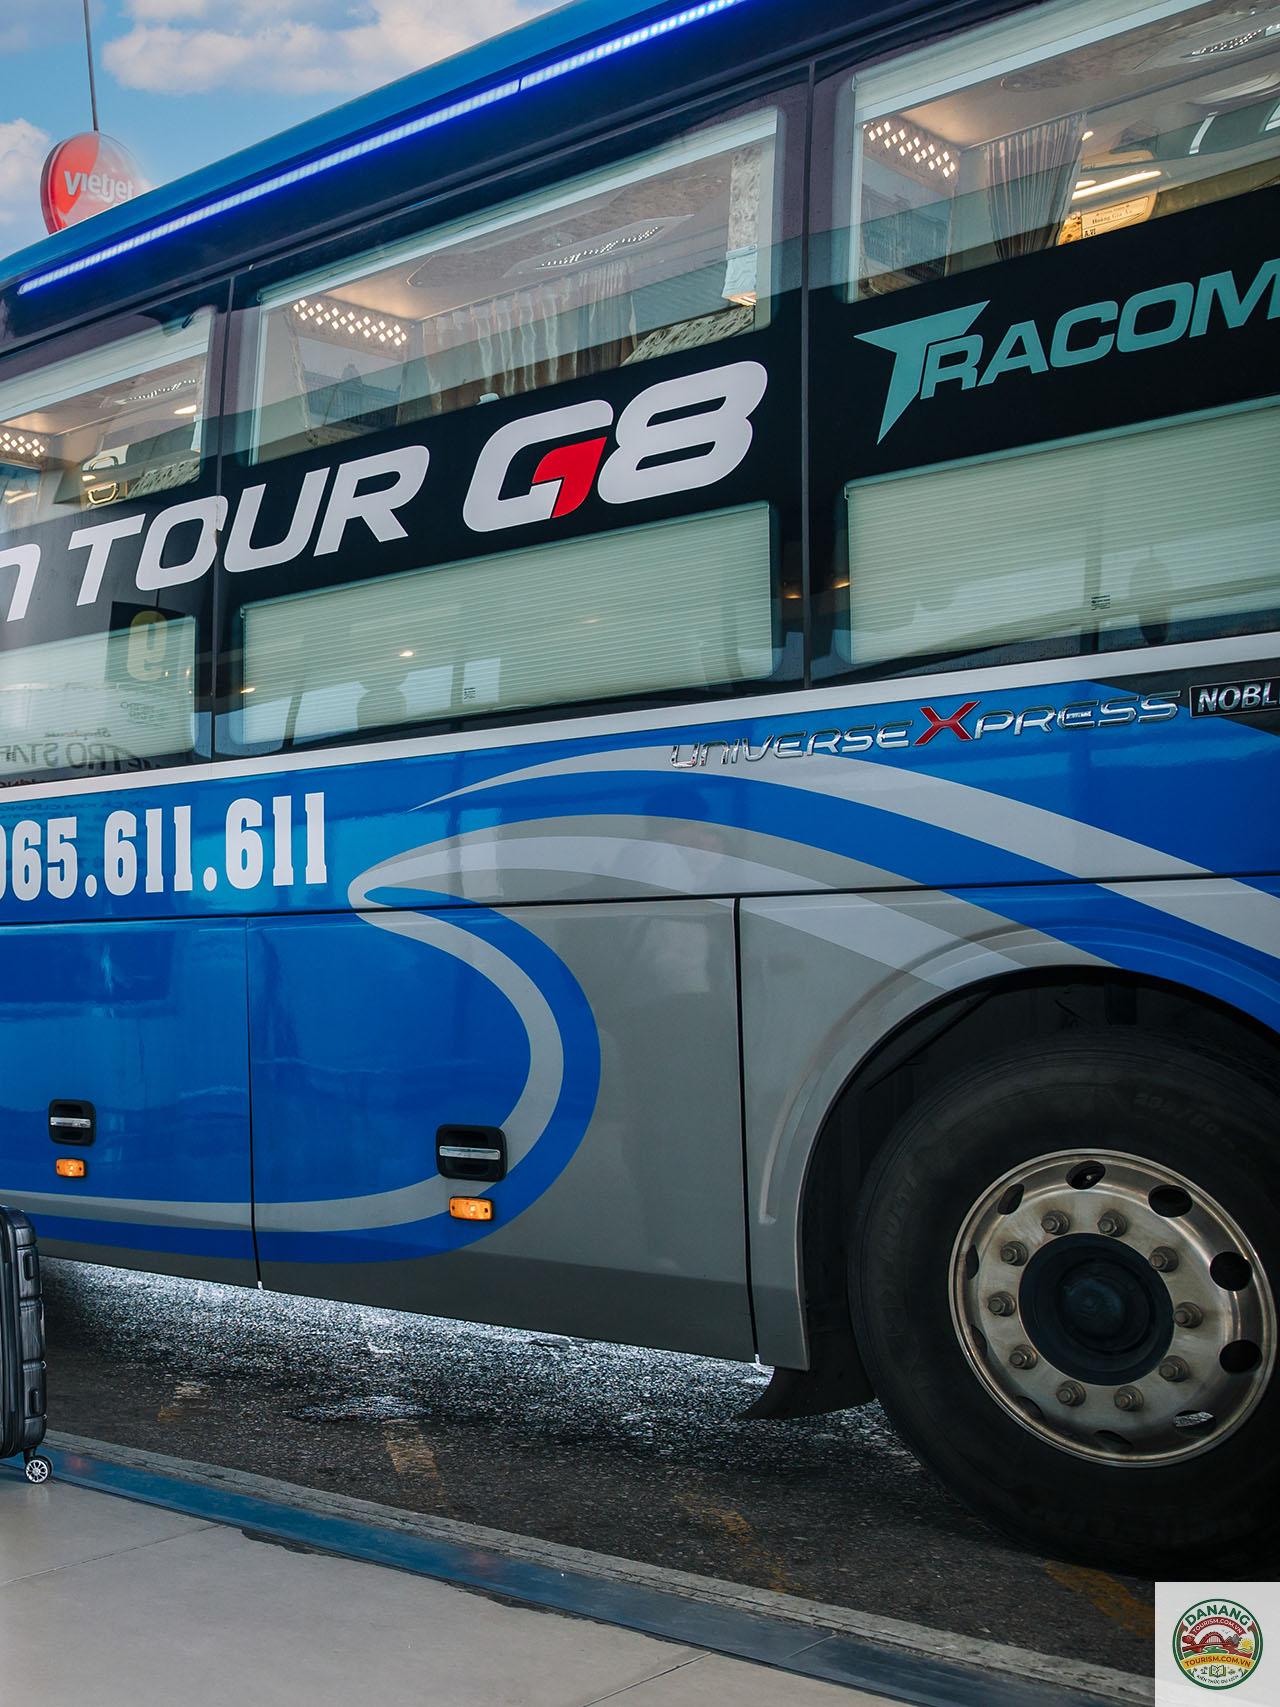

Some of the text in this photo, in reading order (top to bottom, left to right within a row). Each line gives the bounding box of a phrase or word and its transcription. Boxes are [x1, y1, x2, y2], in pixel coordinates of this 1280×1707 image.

[69, 444, 430, 607] TOUR
[462, 361, 768, 533] G8
[1197, 681, 1280, 713] NOBL
